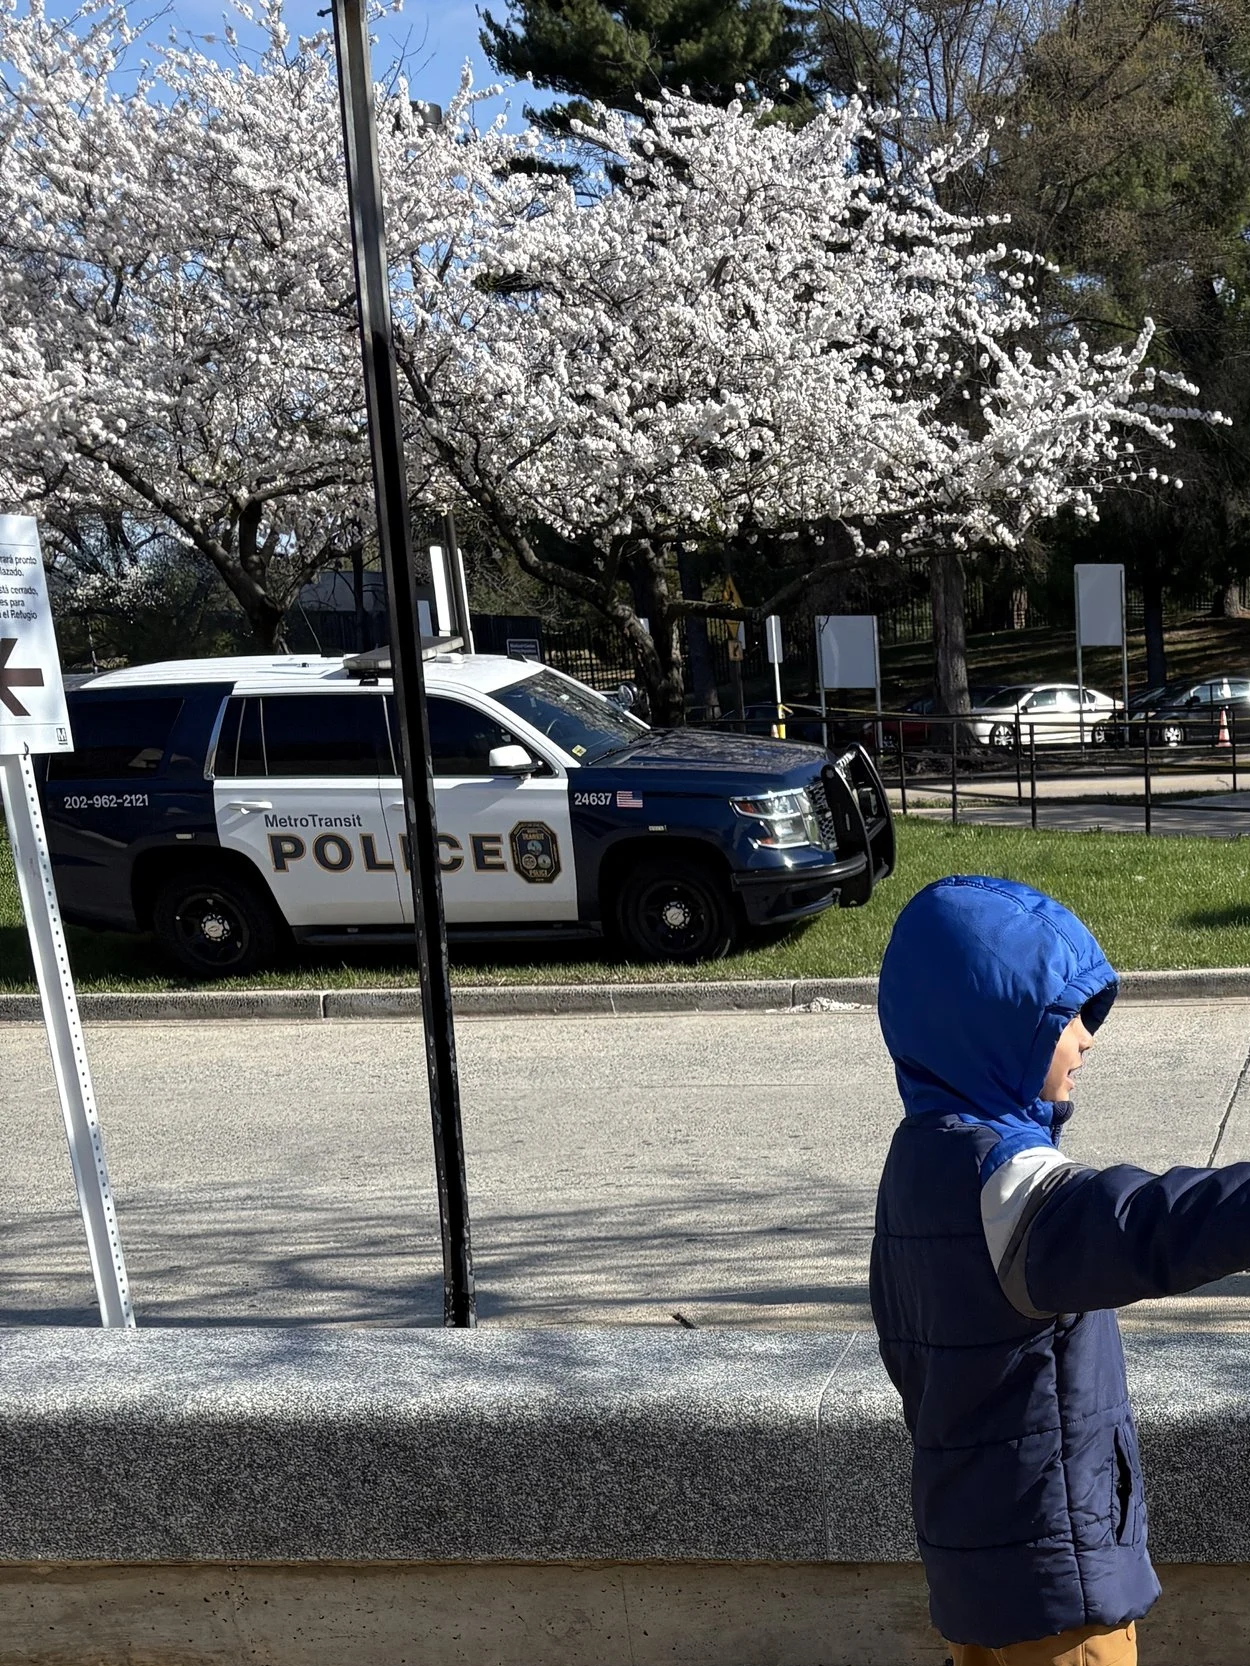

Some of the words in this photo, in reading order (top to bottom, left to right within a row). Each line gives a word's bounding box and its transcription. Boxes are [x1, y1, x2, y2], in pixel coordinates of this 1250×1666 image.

[15, 556, 37, 566] pronto
[10, 600, 25, 608] para
[11, 610, 38, 621] Refugio
[64, 794, 149, 809] 202-962-2121
[574, 793, 612, 806] 24637
[264, 814, 363, 828] MetroTransit
